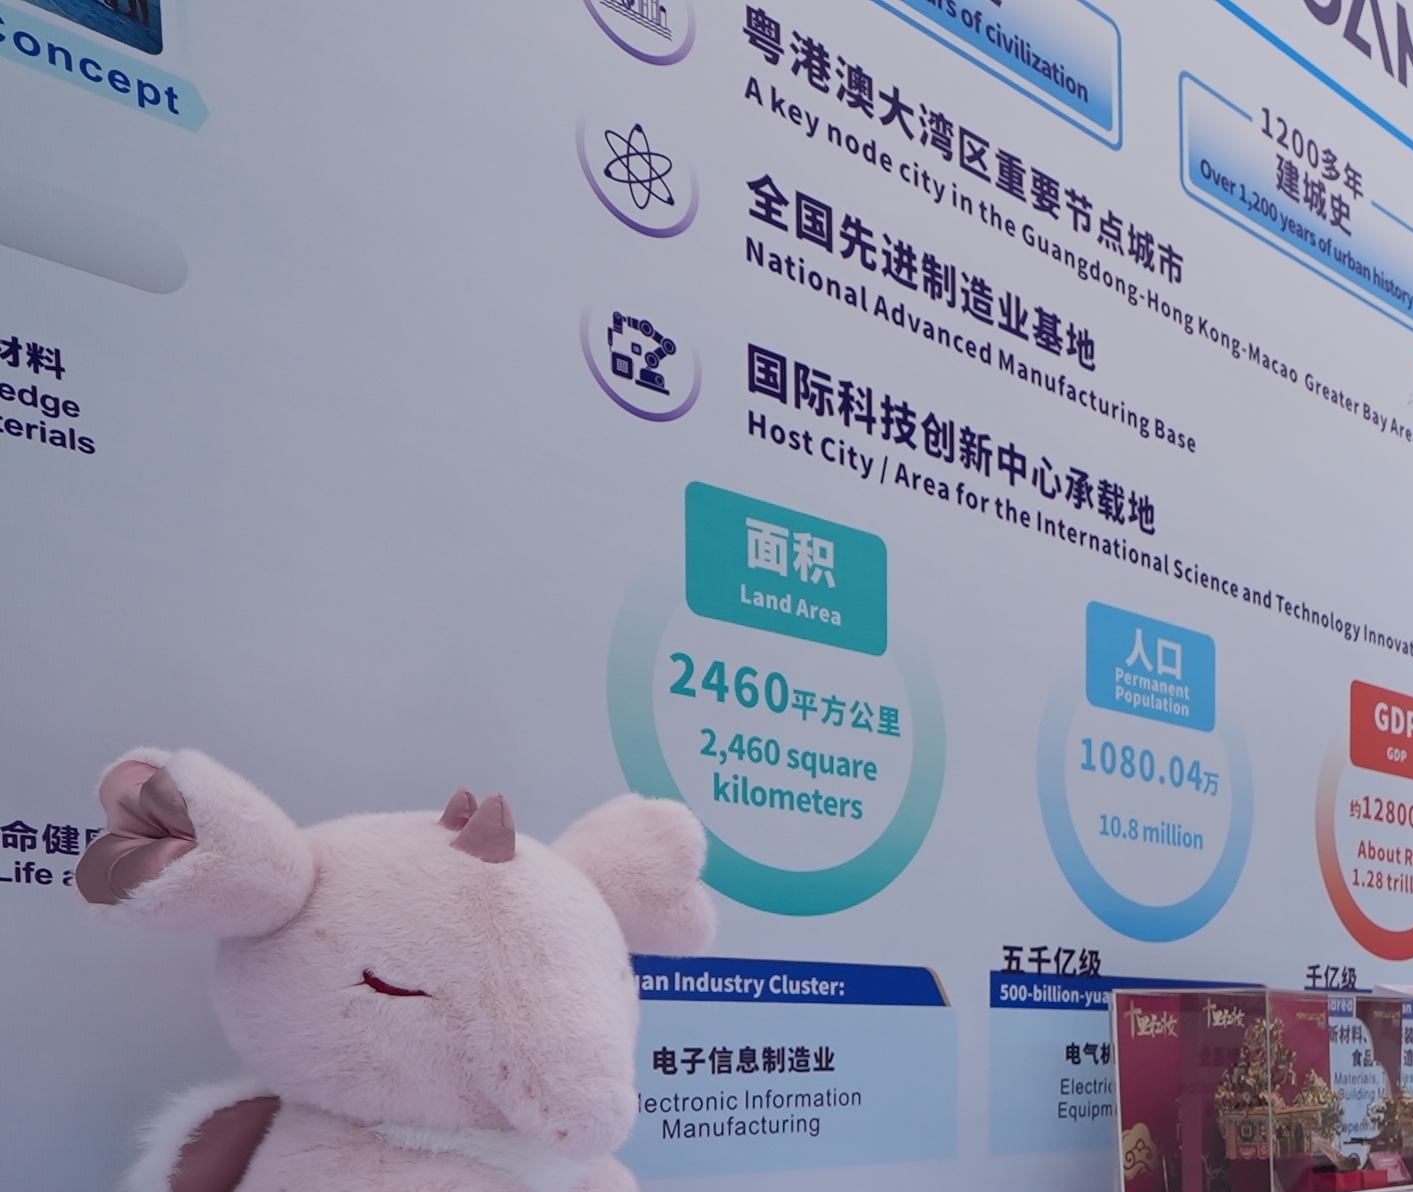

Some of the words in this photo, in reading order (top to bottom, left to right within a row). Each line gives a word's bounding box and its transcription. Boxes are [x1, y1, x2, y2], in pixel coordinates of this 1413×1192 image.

[0, 18, 180, 115] oncept
[961, 8, 982, 34] of
[985, 22, 1088, 103] civilization
[743, 4, 1183, 285] 粤港澳大湾区重要节点城市
[1260, 107, 1364, 201] 1200多年
[1275, 153, 1352, 238] 建城史
[1200, 158, 1237, 197] Over
[1239, 183, 1278, 222] 1,200
[1280, 208, 1316, 246] years
[1319, 231, 1334, 255] of
[1335, 247, 1371, 282] urban
[743, 76, 764, 106] A
[769, 85, 820, 138] key
[827, 116, 893, 174] node
[899, 156, 946, 207] city
[952, 181, 973, 216] in
[977, 189, 1016, 238] the
[1022, 214, 1194, 336] Guangdong-Hong
[1199, 314, 1298, 384] Kong-Macao
[1304, 373, 1360, 418] Greater
[1363, 402, 1388, 434] Bay
[746, 173, 1097, 373] 全国先进制造业基地
[745, 235, 868, 313] National
[873, 295, 992, 366] Advanced
[998, 350, 1149, 440] Manufacturing
[1155, 417, 1197, 453] Base
[747, 342, 1156, 536] 国际科技创新中心承载地
[748, 410, 813, 456] Host
[821, 437, 873, 480] City
[880, 455, 888, 484] /
[894, 462, 950, 502] Area
[957, 483, 990, 514] for
[994, 496, 1031, 529] the
[1036, 510, 1169, 577] International
[1174, 559, 1239, 598] Science
[1242, 582, 1272, 610] and
[1276, 594, 1361, 643] Technology
[745, 516, 837, 589] 面积
[740, 584, 792, 614] Land
[796, 598, 842, 627] Area
[1125, 628, 1183, 681] 人口
[669, 651, 902, 738] 2460平方公里
[1115, 666, 1190, 701] Permanent
[1115, 685, 1190, 718] Population
[700, 728, 781, 766] 2,460
[786, 746, 878, 781] square
[1080, 737, 1220, 797] 1080.04万
[1386, 746, 1408, 763] GDP
[713, 772, 863, 820] kilometers
[1099, 813, 1139, 841] 10.8
[1142, 818, 1204, 851] million
[1357, 839, 1402, 866] About
[0, 860, 54, 887] ife
[1352, 868, 1384, 890] 1.28
[674, 971, 765, 999] Industry
[768, 974, 846, 997] Cluster:
[1001, 944, 1102, 979] 五千亿级
[1306, 964, 1357, 991] 千亿级
[1000, 983, 1112, 1008] 500-billion-yua
[652, 1046, 836, 1076] 电子信息制造业
[637, 1090, 738, 1114] lectronic
[744, 1088, 862, 1111] Information
[1058, 1101, 1116, 1121] Equipm
[662, 1114, 821, 1140] Manufacturing
